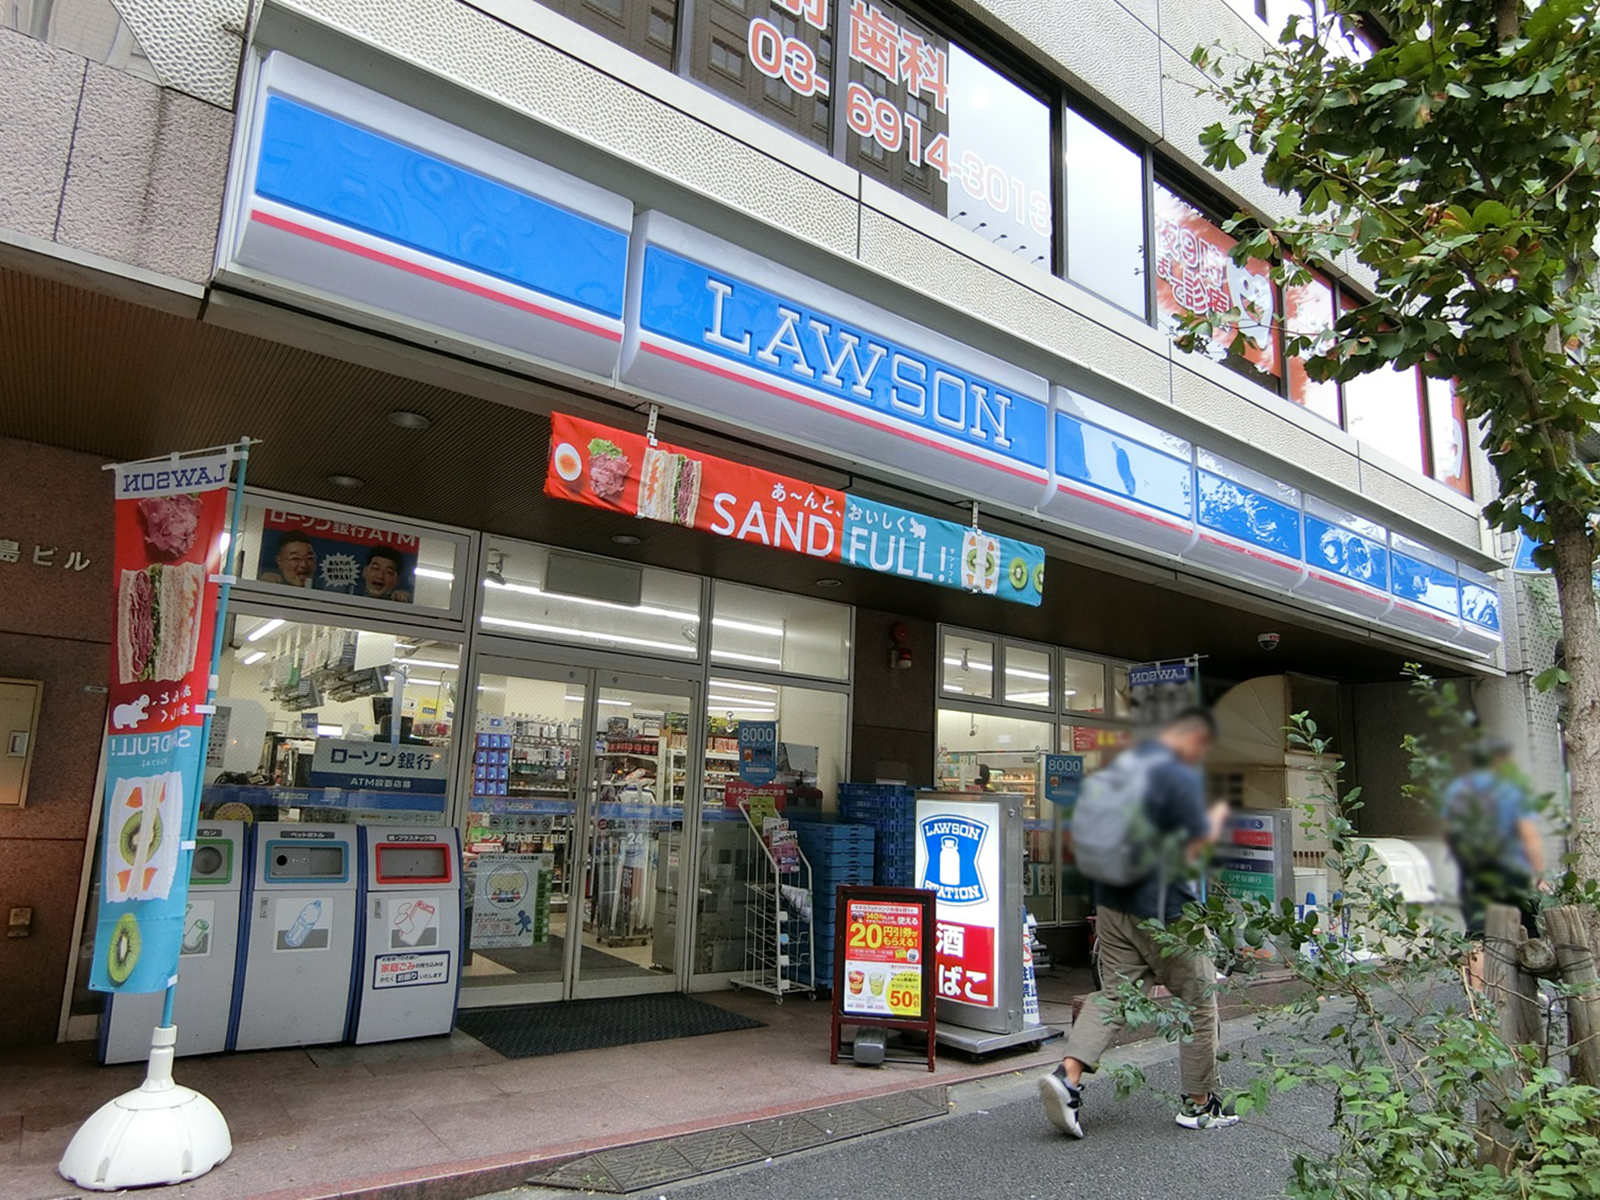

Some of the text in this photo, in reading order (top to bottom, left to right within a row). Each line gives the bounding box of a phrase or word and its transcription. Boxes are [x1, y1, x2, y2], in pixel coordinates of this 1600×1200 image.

[703, 275, 1014, 450] LAWSON
[710, 491, 948, 583] SAND FULL!
[741, 727, 774, 743] 8000
[330, 748, 433, 771] ローソン銀行
[1048, 758, 1081, 772] 8000
[925, 822, 981, 842] LAWSON
[924, 880, 981, 901] STATION
[849, 923, 883, 949] 20
[935, 922, 966, 959] 酒
[937, 964, 989, 1002] ばこ
[889, 989, 913, 1008] 50
